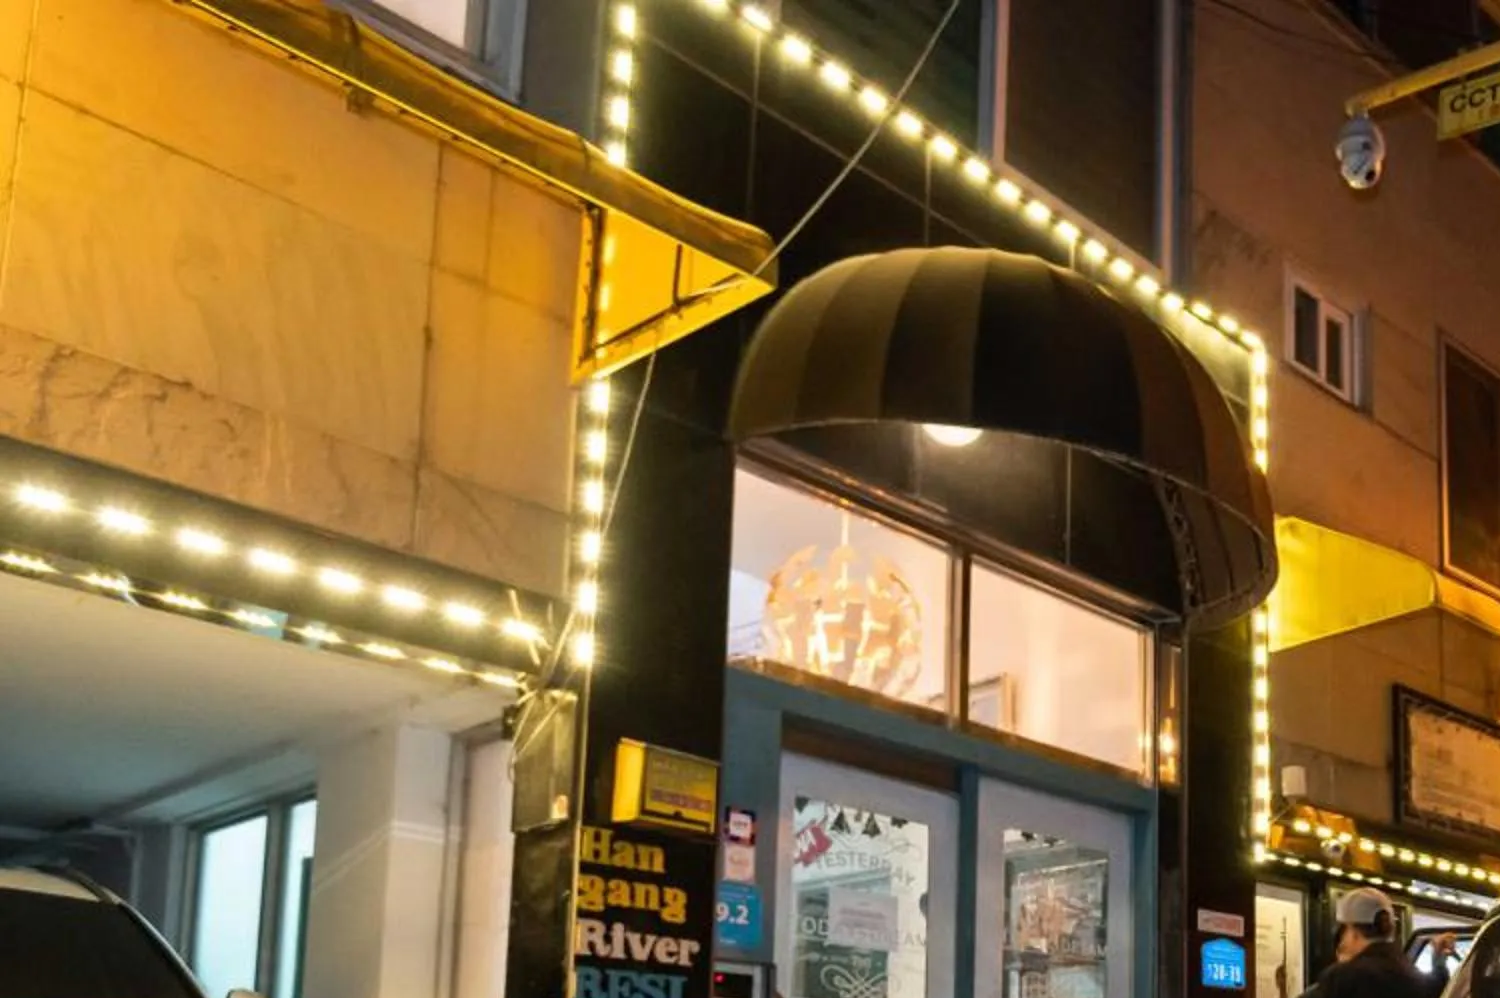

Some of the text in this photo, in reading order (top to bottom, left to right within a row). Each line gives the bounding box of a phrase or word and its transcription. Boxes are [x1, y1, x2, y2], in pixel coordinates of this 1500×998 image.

[580, 826, 666, 873] Han
[577, 874, 688, 924] gang
[715, 902, 750, 925] 9.2
[575, 917, 700, 967] River
